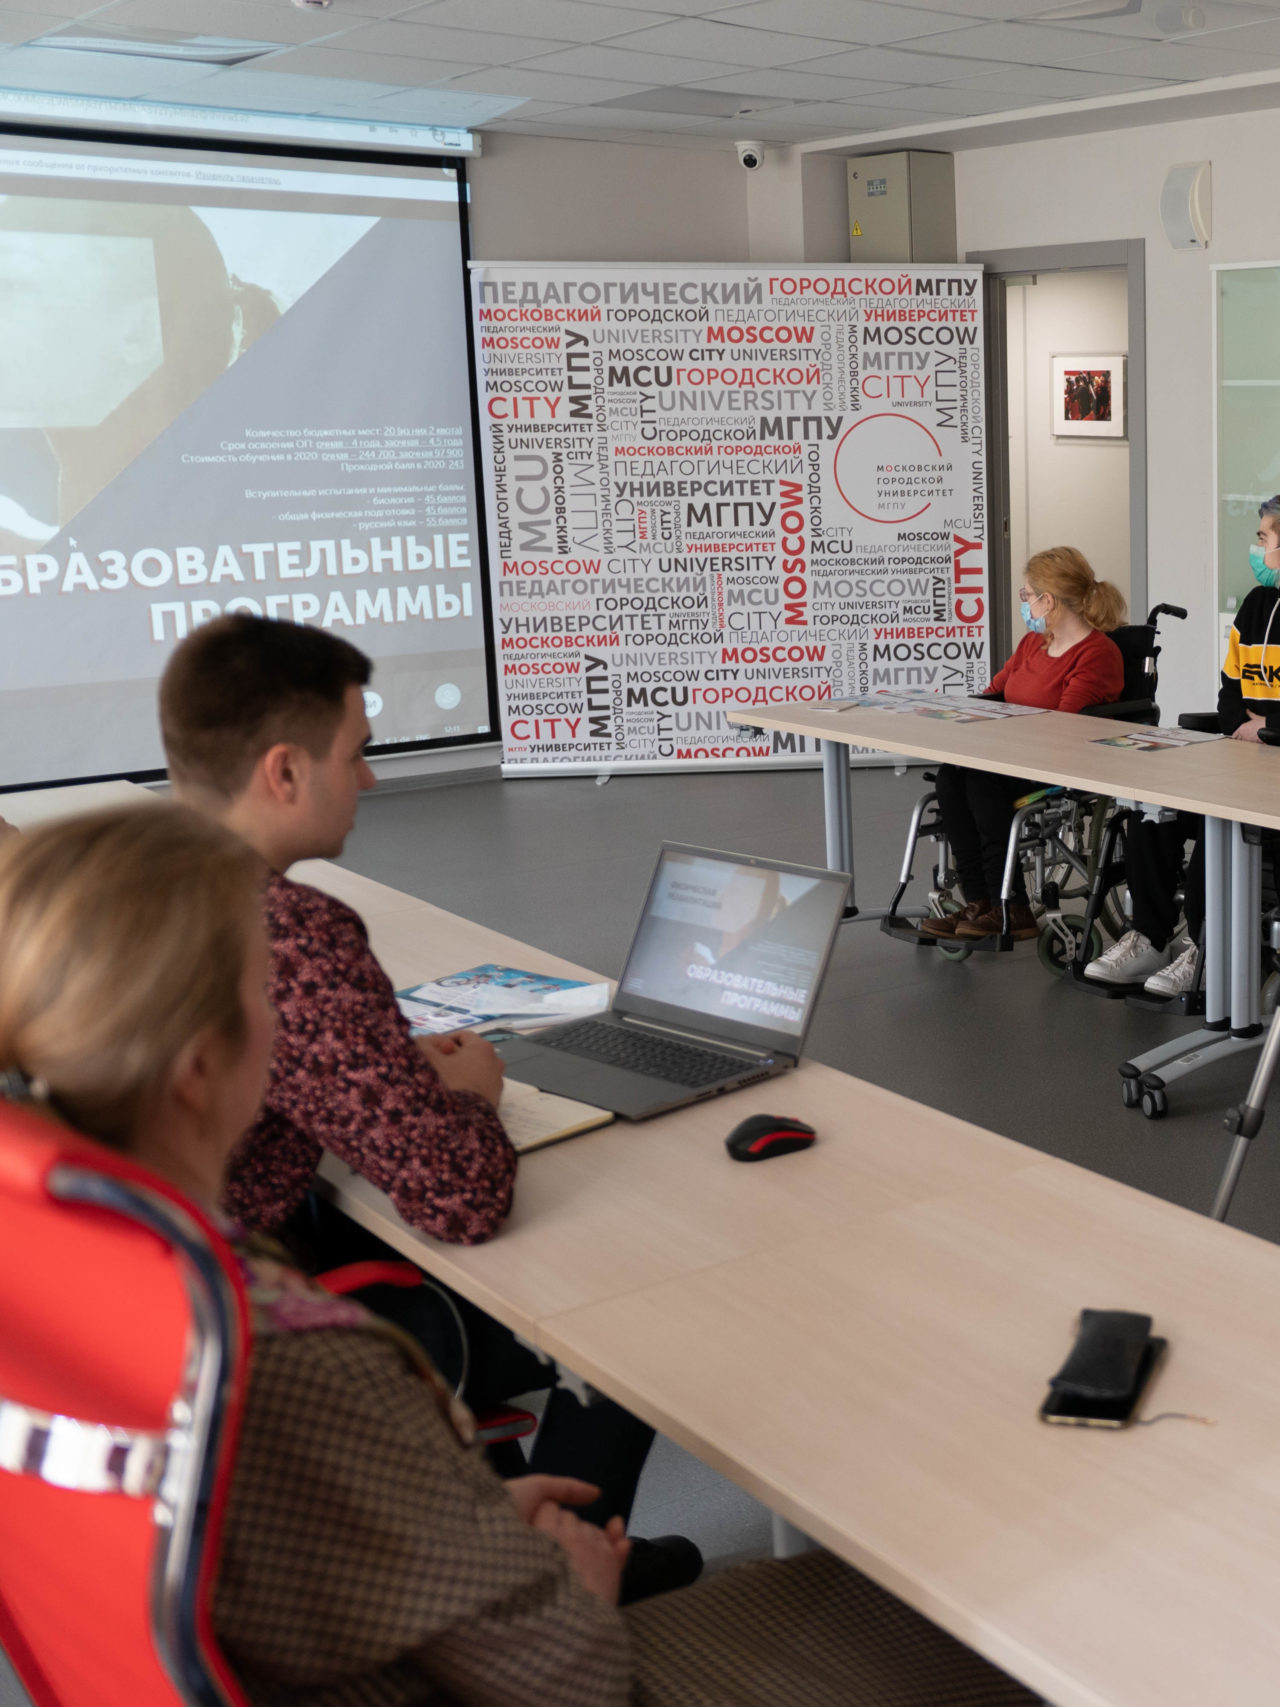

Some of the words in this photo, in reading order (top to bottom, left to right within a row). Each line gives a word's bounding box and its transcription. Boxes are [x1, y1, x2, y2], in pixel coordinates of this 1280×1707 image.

[479, 277, 763, 307] ПЕДАГОГИЧЕСКИЙ
[769, 274, 913, 298] ГОРОДСКОЙ
[915, 279, 978, 296] МГПУ
[771, 297, 855, 306] ПЕДАГОГИЧЕСКИЙ
[859, 298, 976, 309] ПЕДАГОГИЧЕСКИЙ
[479, 306, 601, 322] МОСКОВСКИЙ
[606, 307, 709, 323] ГОРОДСКОЙ
[715, 306, 859, 323] ПЕДАГОГИЧЕСКИЙ
[864, 309, 978, 322] УНИВЕРСИТЕТ
[481, 325, 561, 334] ПЕДАГОГИЧЕСКИЙ
[593, 329, 702, 344] UNIVERSITY
[707, 326, 814, 344] MOSCOW
[863, 326, 978, 346] MOSCOW
[481, 337, 561, 349] MOSCOW
[482, 353, 563, 364] UNIVERSITY
[608, 349, 685, 361] MOSCOW
[689, 349, 726, 361] CITY
[731, 349, 821, 361] UNIVERSITY
[862, 351, 930, 370] МГПУ
[484, 367, 563, 377] УНИВЕРСИТЕТ
[565, 329, 593, 419] МГПУ
[608, 366, 672, 387] MCU
[676, 364, 821, 388] ГОРОДСКОЙ
[820, 324, 837, 411] ГОРОДСКОЙ
[836, 324, 848, 412] ПЕДАГОГИЧЕСКИЙ
[848, 324, 862, 412] МОСКОВСКИЙ
[485, 380, 564, 393] MOSCOW
[593, 351, 609, 432] ГОРОДСКОЙ
[862, 375, 930, 399] CITY
[935, 350, 958, 428] МГПУ
[970, 348, 983, 424] ГОРОДСКОЙ
[658, 390, 817, 411] UNIVERSITY
[958, 348, 970, 443] ПЕДАГОГИЧЕСКИЙ
[487, 396, 561, 419] CITY
[609, 407, 638, 417] MCU
[639, 391, 657, 441] CITY
[507, 423, 593, 433] УНИВЕРСИТЕТ
[610, 420, 638, 430] CITY
[659, 416, 756, 426] ПЕДАГОГИЧЕСКИЙ
[759, 416, 843, 441] МГПУ
[508, 437, 594, 449] UNIVERSITY
[659, 427, 757, 441] ГОРОДСКОЙ
[971, 426, 983, 456] CITY
[220, 440, 246, 451] Срок
[615, 443, 713, 457] МОСКОВСКИЙ
[717, 442, 802, 456] ГОРОДСКОЙ
[181, 454, 238, 463] Стоимость
[567, 451, 593, 461] CITY
[341, 462, 394, 472] Проходной
[614, 456, 803, 477] ПЕДАГОГИЧЕСКИЙ
[877, 463, 953, 472] МОСКОВСКИЙ
[614, 479, 775, 498] УНИВЕРСИТЕТ
[877, 476, 943, 485] ГОРОДСКОЙ
[490, 423, 512, 558] ПЕДАГОГИЧЕСКИЙ
[597, 437, 615, 554] ПЕДАГОГИЧЕСКИЙ
[807, 443, 825, 537] ГОРОДСКОЙ
[877, 488, 954, 497] УНИВЕРСИТЕТ
[514, 455, 553, 553] MCU
[552, 452, 571, 555] МОСКОВСКИЙ
[568, 463, 599, 553] МГПУ
[877, 502, 906, 510] МГПУ
[971, 461, 984, 541] UNIVERSITY
[686, 502, 776, 527] МГПУ
[943, 518, 972, 529] MCU
[614, 499, 637, 553] CITY
[638, 508, 648, 540] МГПУ
[660, 509, 672, 540] CITY
[674, 500, 684, 553] ГОРОДСКОЙ
[826, 527, 853, 537] CITY
[685, 529, 776, 540] ПЕДАГОГИЧЕСКИЙ
[897, 532, 950, 541] MOSCOW
[639, 542, 674, 554] MCU
[686, 542, 776, 553] УНИВЕРСИТЕТ
[779, 479, 808, 627] MOSCOW
[811, 540, 853, 554] MCU
[856, 543, 951, 553] ПЕДАГОГИЧЕСКИЙ
[502, 559, 602, 576] MOSCOW
[607, 559, 652, 574] CITY
[659, 556, 776, 573] UNIVERSITY
[811, 555, 885, 566] МОСКОВСКИЙ
[887, 554, 952, 565] ГОРОДСКОЙ
[726, 576, 779, 585] MOSCOW
[811, 567, 889, 577] ПЕДАГОГИЧЕСКИЙ
[891, 567, 950, 575] УНИВЕРСИТЕТ
[954, 534, 984, 624] CITY
[500, 572, 707, 598] ПЕДАГОГИЧЕСКИЙ
[813, 578, 930, 599] MOSCOW
[500, 600, 591, 613] МОСКОВСКИЙ
[596, 593, 708, 611] ГОРОДСКОЙ
[716, 573, 726, 628] МОСКОВСКИЙ
[727, 588, 779, 606] MCU
[812, 601, 835, 611] CITY
[839, 600, 900, 610] UNIVERSITY
[932, 576, 946, 622] МГПУ
[813, 612, 900, 626] ГОРОДСКОЙ
[903, 605, 930, 615] MCU
[499, 613, 666, 634] УНИВЕРСИТЕТ
[668, 618, 709, 631] МГПУ
[728, 612, 782, 630] CITY
[501, 631, 620, 650] МОСКОВСКИЙ
[625, 629, 724, 647] ГОРОДСКОЙ
[729, 626, 869, 645] ПЕДАГОГИЧЕСКИЙ
[874, 625, 984, 640] УНИВЕРСИТЕТ
[503, 650, 580, 661] ПЕДАГОГИЧЕСКИЙ
[611, 650, 718, 667] UNIVERSITY
[721, 645, 826, 664] MOSCOW
[873, 641, 984, 662] MOSCOW
[504, 662, 580, 675] MOSCOW
[627, 670, 700, 683] MOSCOW
[704, 669, 739, 681] CITY
[745, 666, 833, 680] UNIVERSITY
[873, 666, 938, 686] МГПУ
[504, 677, 583, 690] UNIVERSITY
[506, 691, 583, 701] УНИВЕРСИТЕТ
[584, 654, 612, 739] МГПУ
[626, 686, 688, 707] MCU
[692, 681, 832, 706] ГОРОДСКОЙ
[507, 703, 583, 716] MOSCOW
[611, 674, 627, 750] ГОРОДСКОЙ
[510, 718, 581, 741] CITY
[628, 726, 655, 736] MCU
[657, 710, 674, 757] CITY
[529, 742, 612, 753] УНИВЕРСИТЕТ
[629, 738, 655, 748] CITY
[686, 964, 808, 1004] ОБРАЗОВАТЕЛЬНЫЕ
[721, 991, 803, 1022] ПРОГРАММЫ
